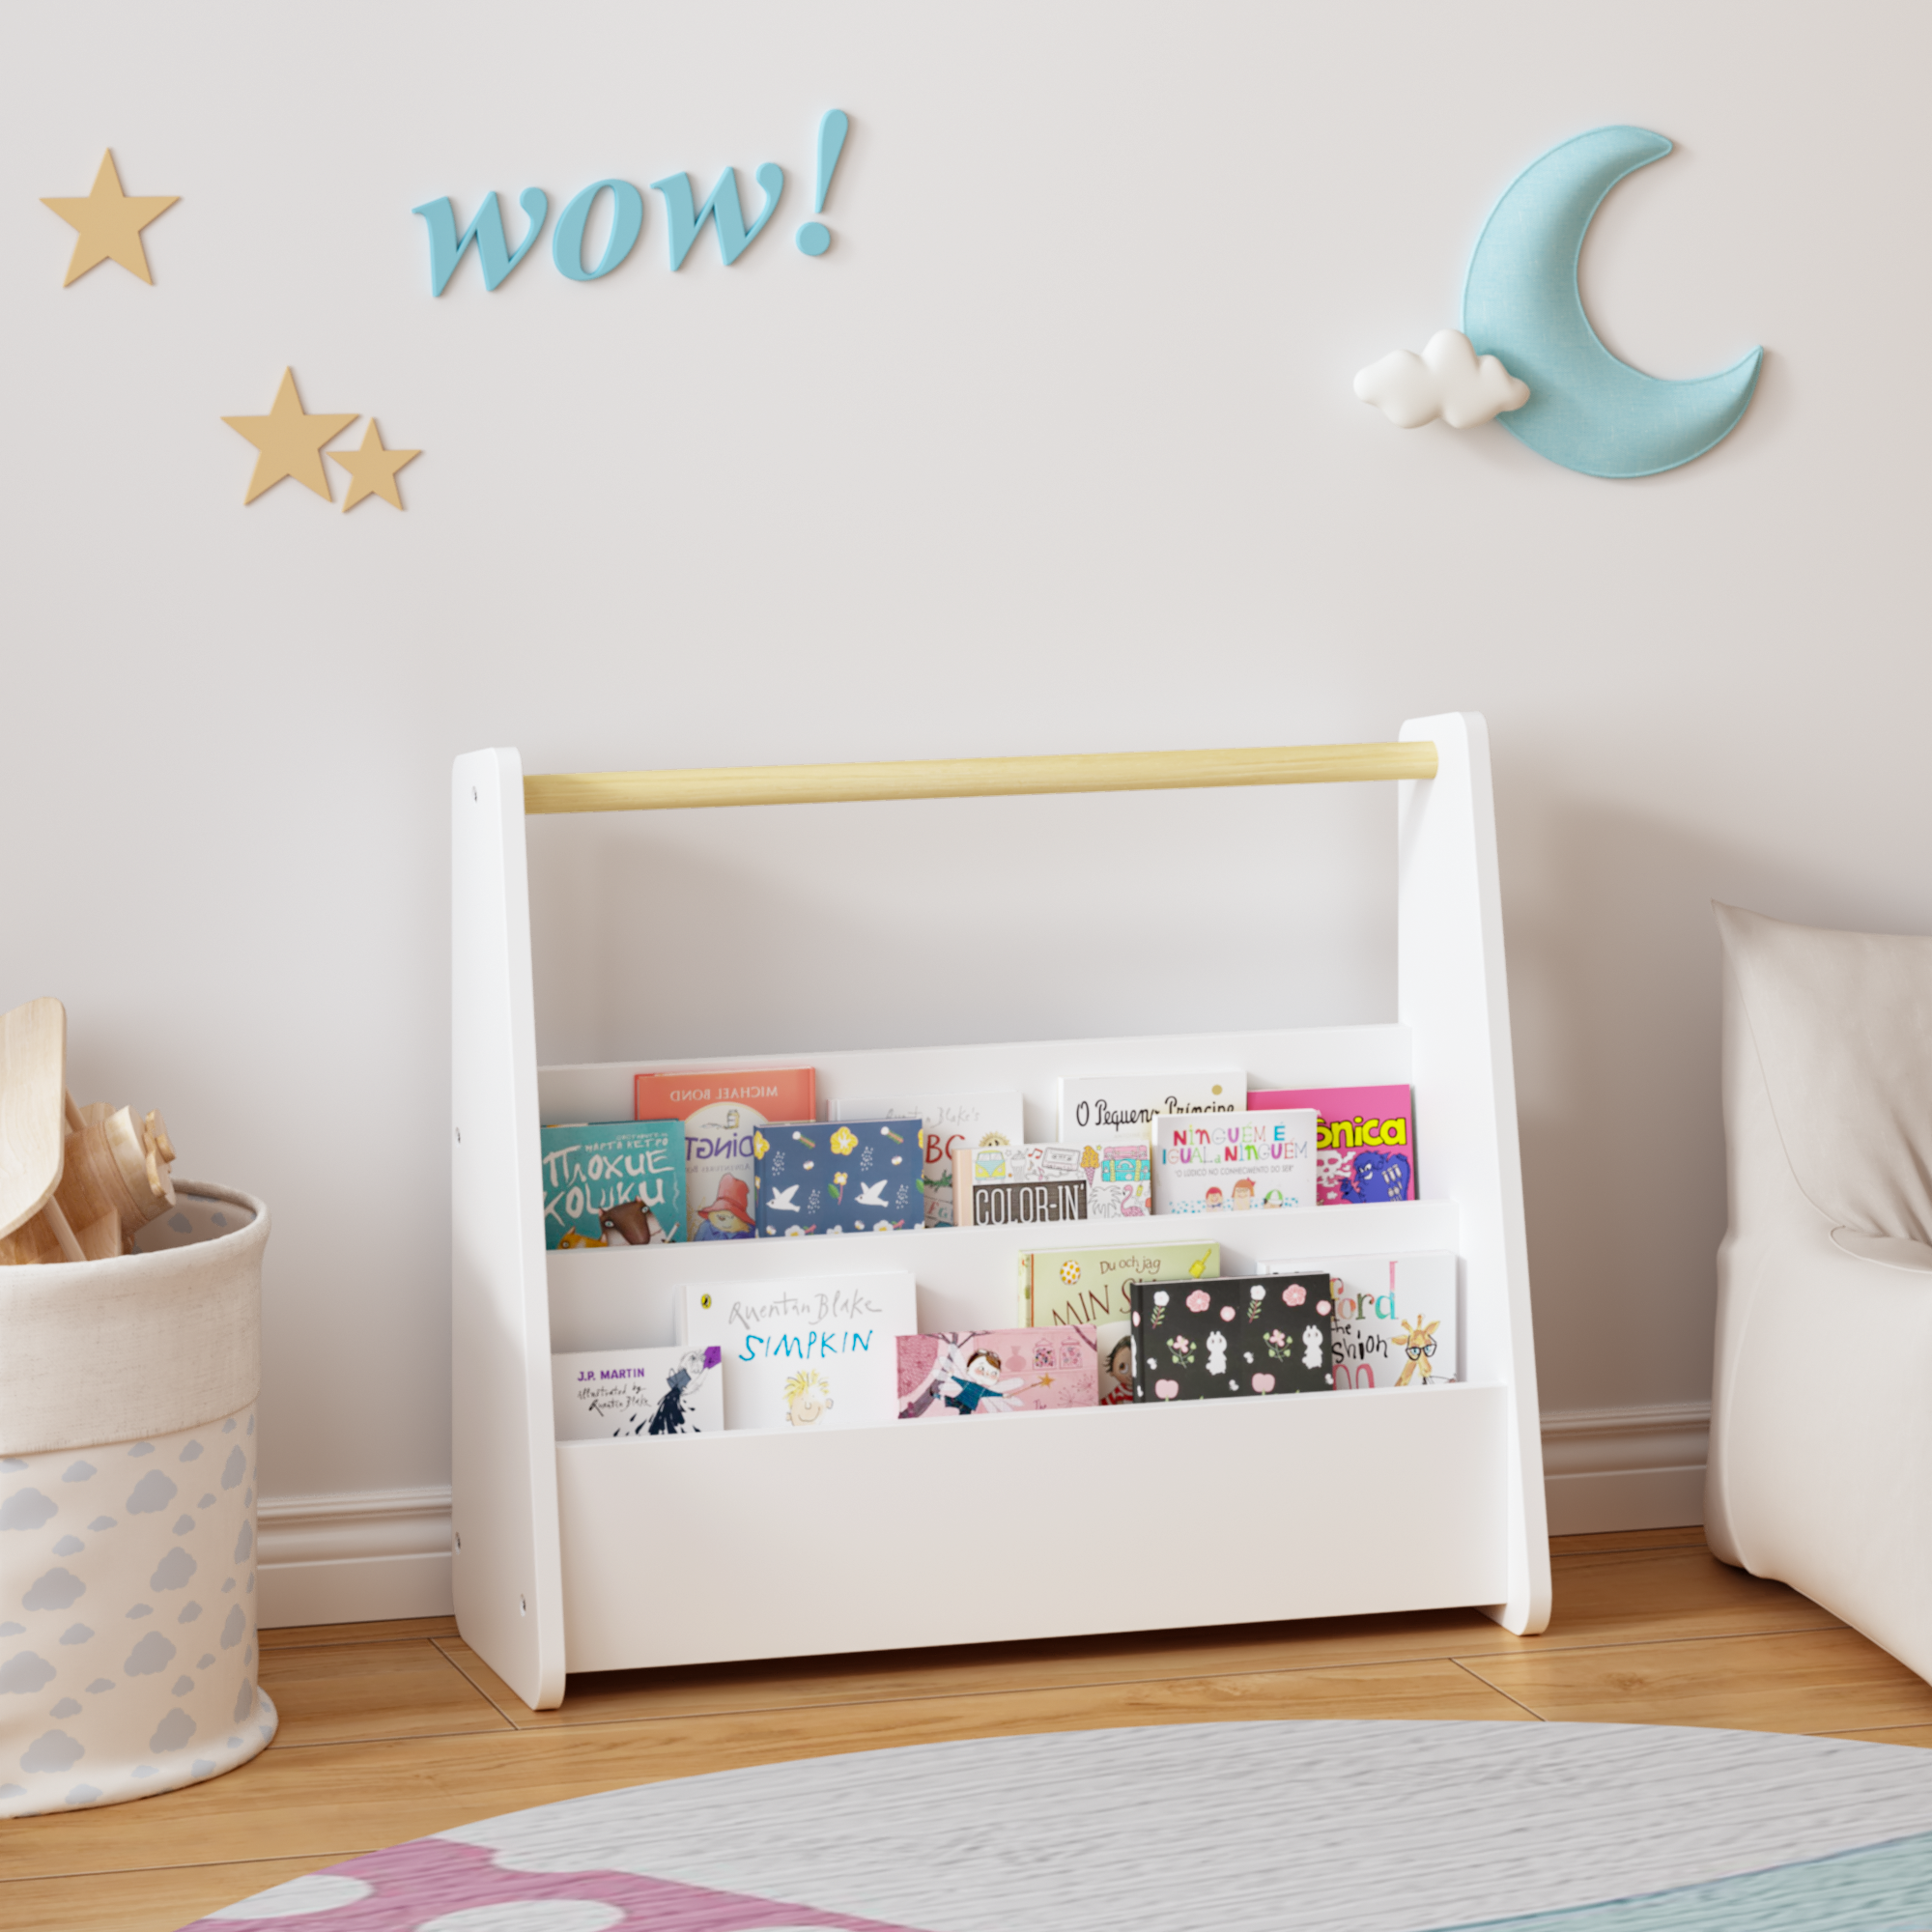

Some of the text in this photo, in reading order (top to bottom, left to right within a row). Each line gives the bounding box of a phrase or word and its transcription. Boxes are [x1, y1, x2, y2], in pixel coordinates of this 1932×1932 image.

[1075, 1100, 1090, 1127] O
[1099, 1256, 1161, 1275] Du och jag
[809, 1289, 883, 1325] Blake
[1052, 1284, 1110, 1326] MIN
[738, 1329, 873, 1362] SIMPKIN
[577, 1367, 645, 1382] J.P. MARTIN
